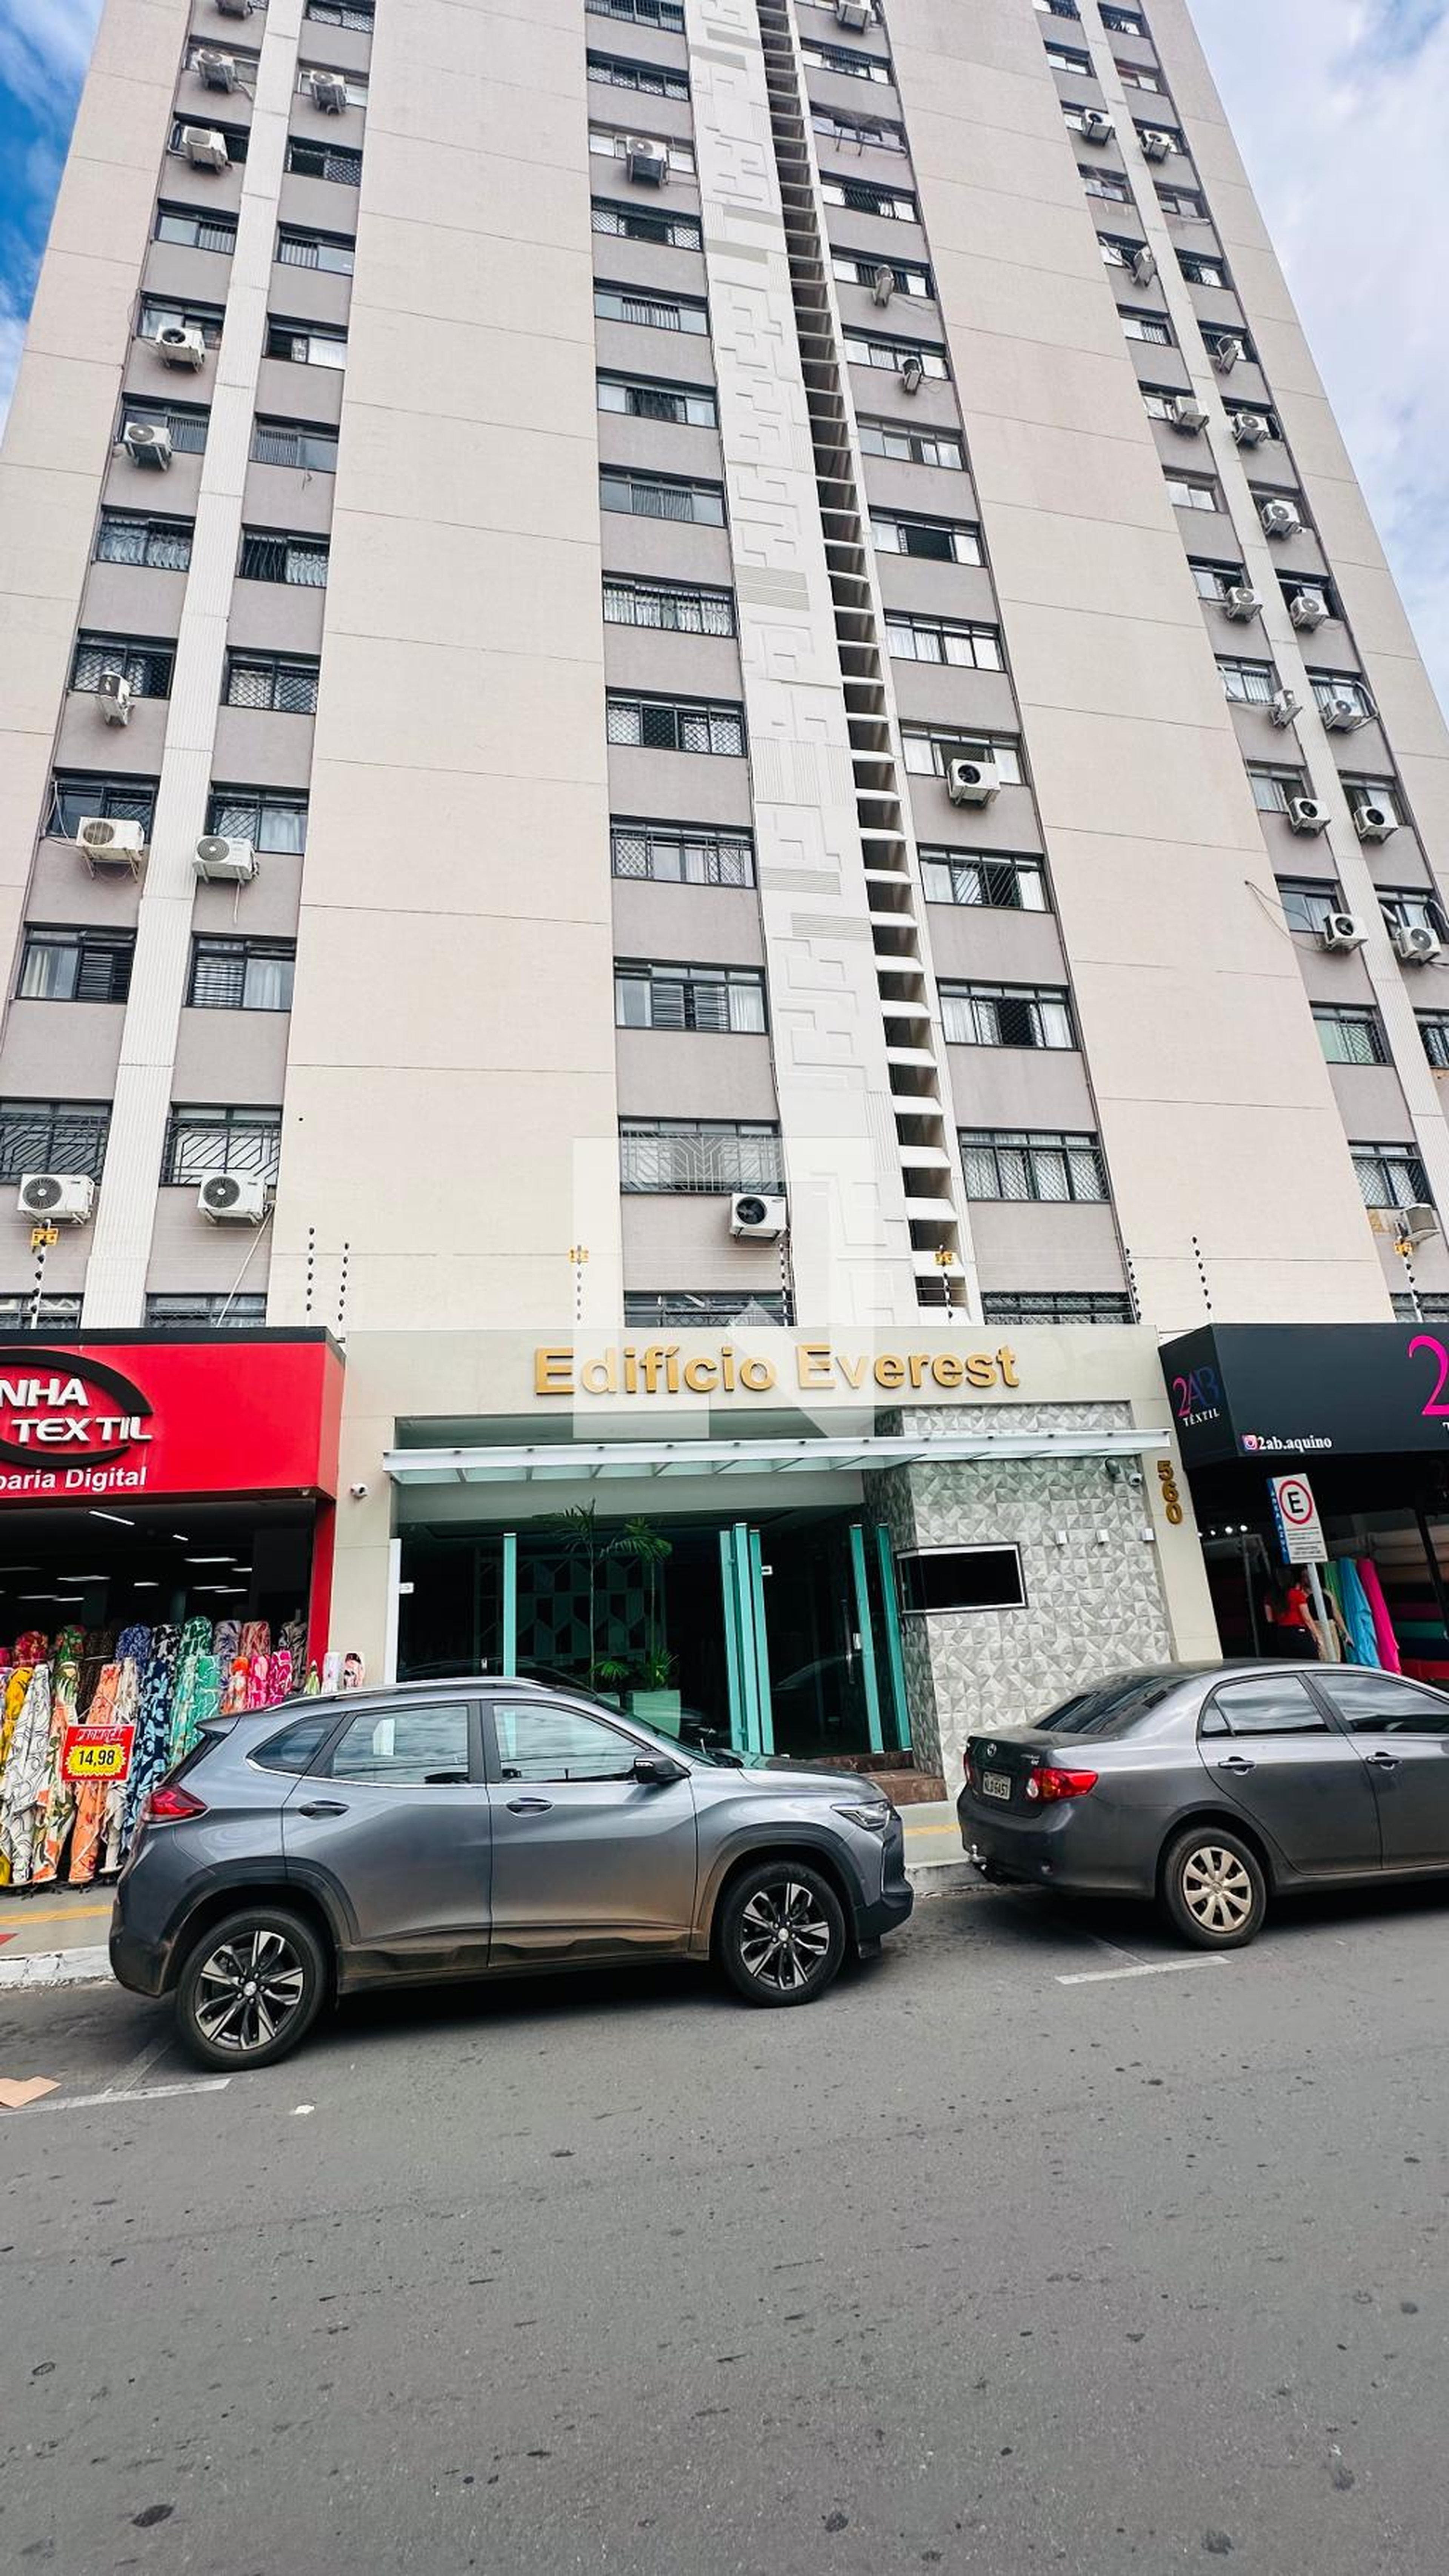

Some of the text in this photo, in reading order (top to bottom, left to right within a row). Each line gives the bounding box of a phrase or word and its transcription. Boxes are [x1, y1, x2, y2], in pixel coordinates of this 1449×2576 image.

[535, 1344, 1020, 1395] Edifício Everest
[1258, 1435, 1332, 1453] 2ab.aquino
[65, 1467, 147, 1492] Digital
[1157, 1460, 1182, 1524] 560
[1287, 1492, 1304, 1514] E
[79, 1750, 115, 1768] 14,98
